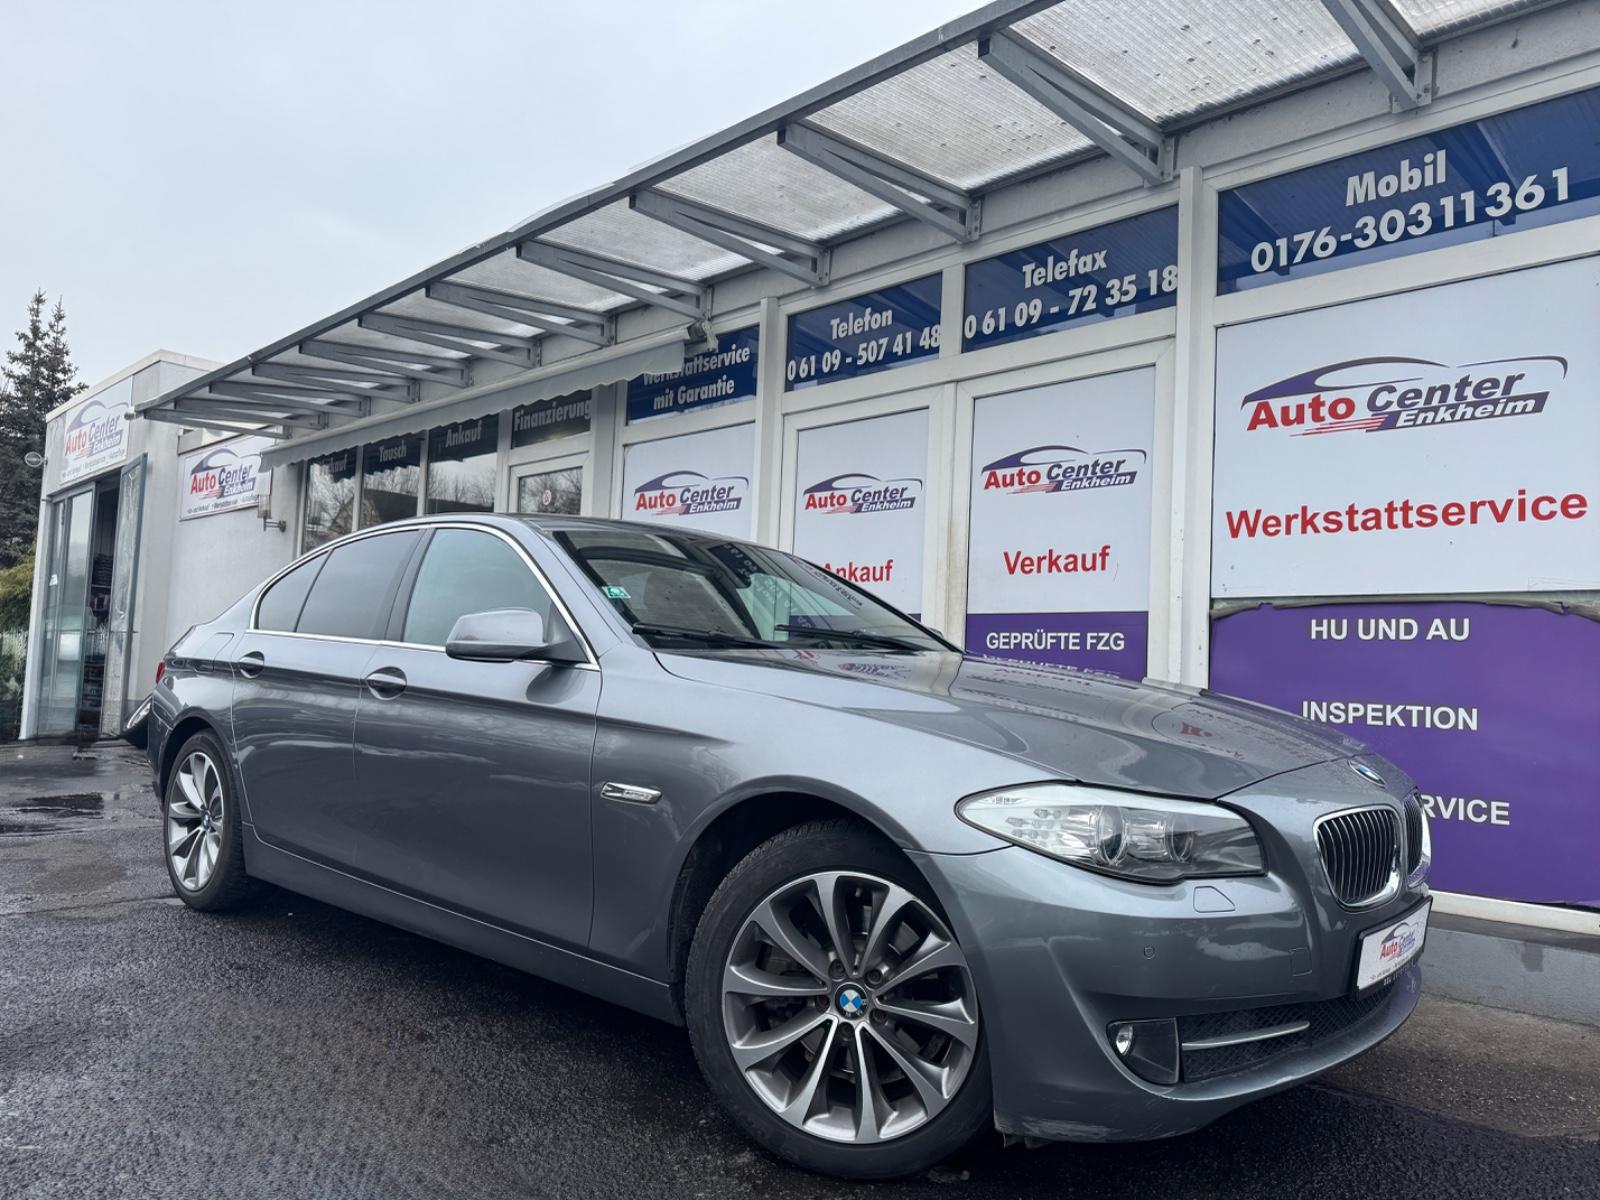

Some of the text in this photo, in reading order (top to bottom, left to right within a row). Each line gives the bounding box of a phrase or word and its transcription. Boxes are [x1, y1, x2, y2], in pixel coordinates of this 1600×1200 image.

[1345, 149, 1447, 207] Mobil
[1022, 249, 1107, 289] Telefax
[982, 308, 1005, 335] 61
[1014, 298, 1042, 327] 09
[1068, 284, 1097, 315] 72
[1105, 274, 1136, 306] 35
[1148, 265, 1178, 296] 18
[830, 307, 893, 340] Telefon
[822, 349, 841, 374] 09
[857, 339, 888, 366] 507
[893, 333, 912, 357] 41
[919, 324, 941, 350] 48
[653, 375, 735, 410] mit Garantie
[1246, 373, 1526, 431] Auto Center
[513, 399, 592, 432] Finanzierung
[1395, 396, 1536, 428] Enkheim
[65, 415, 121, 456] Auto Center
[445, 422, 483, 448] Ankauf
[379, 440, 407, 463] Tausch
[190, 464, 253, 495] Auto Center
[984, 456, 1126, 490] Auto Center
[1060, 473, 1131, 491] Enkheim
[635, 484, 735, 512] Auto Center
[689, 499, 738, 514] Enkheim
[804, 485, 908, 510] Auto Center
[861, 499, 912, 513] Enkheim
[1225, 489, 1589, 539] Werkstattservice
[1003, 545, 1111, 576] Verkauf
[985, 628, 1125, 650] GEPRÜFTE FZG
[1310, 618, 1470, 641] HU UND AU
[1302, 700, 1479, 731] INSPEKTION
[1420, 794, 1510, 826] RVICE
[1379, 941, 1398, 960] Auto
